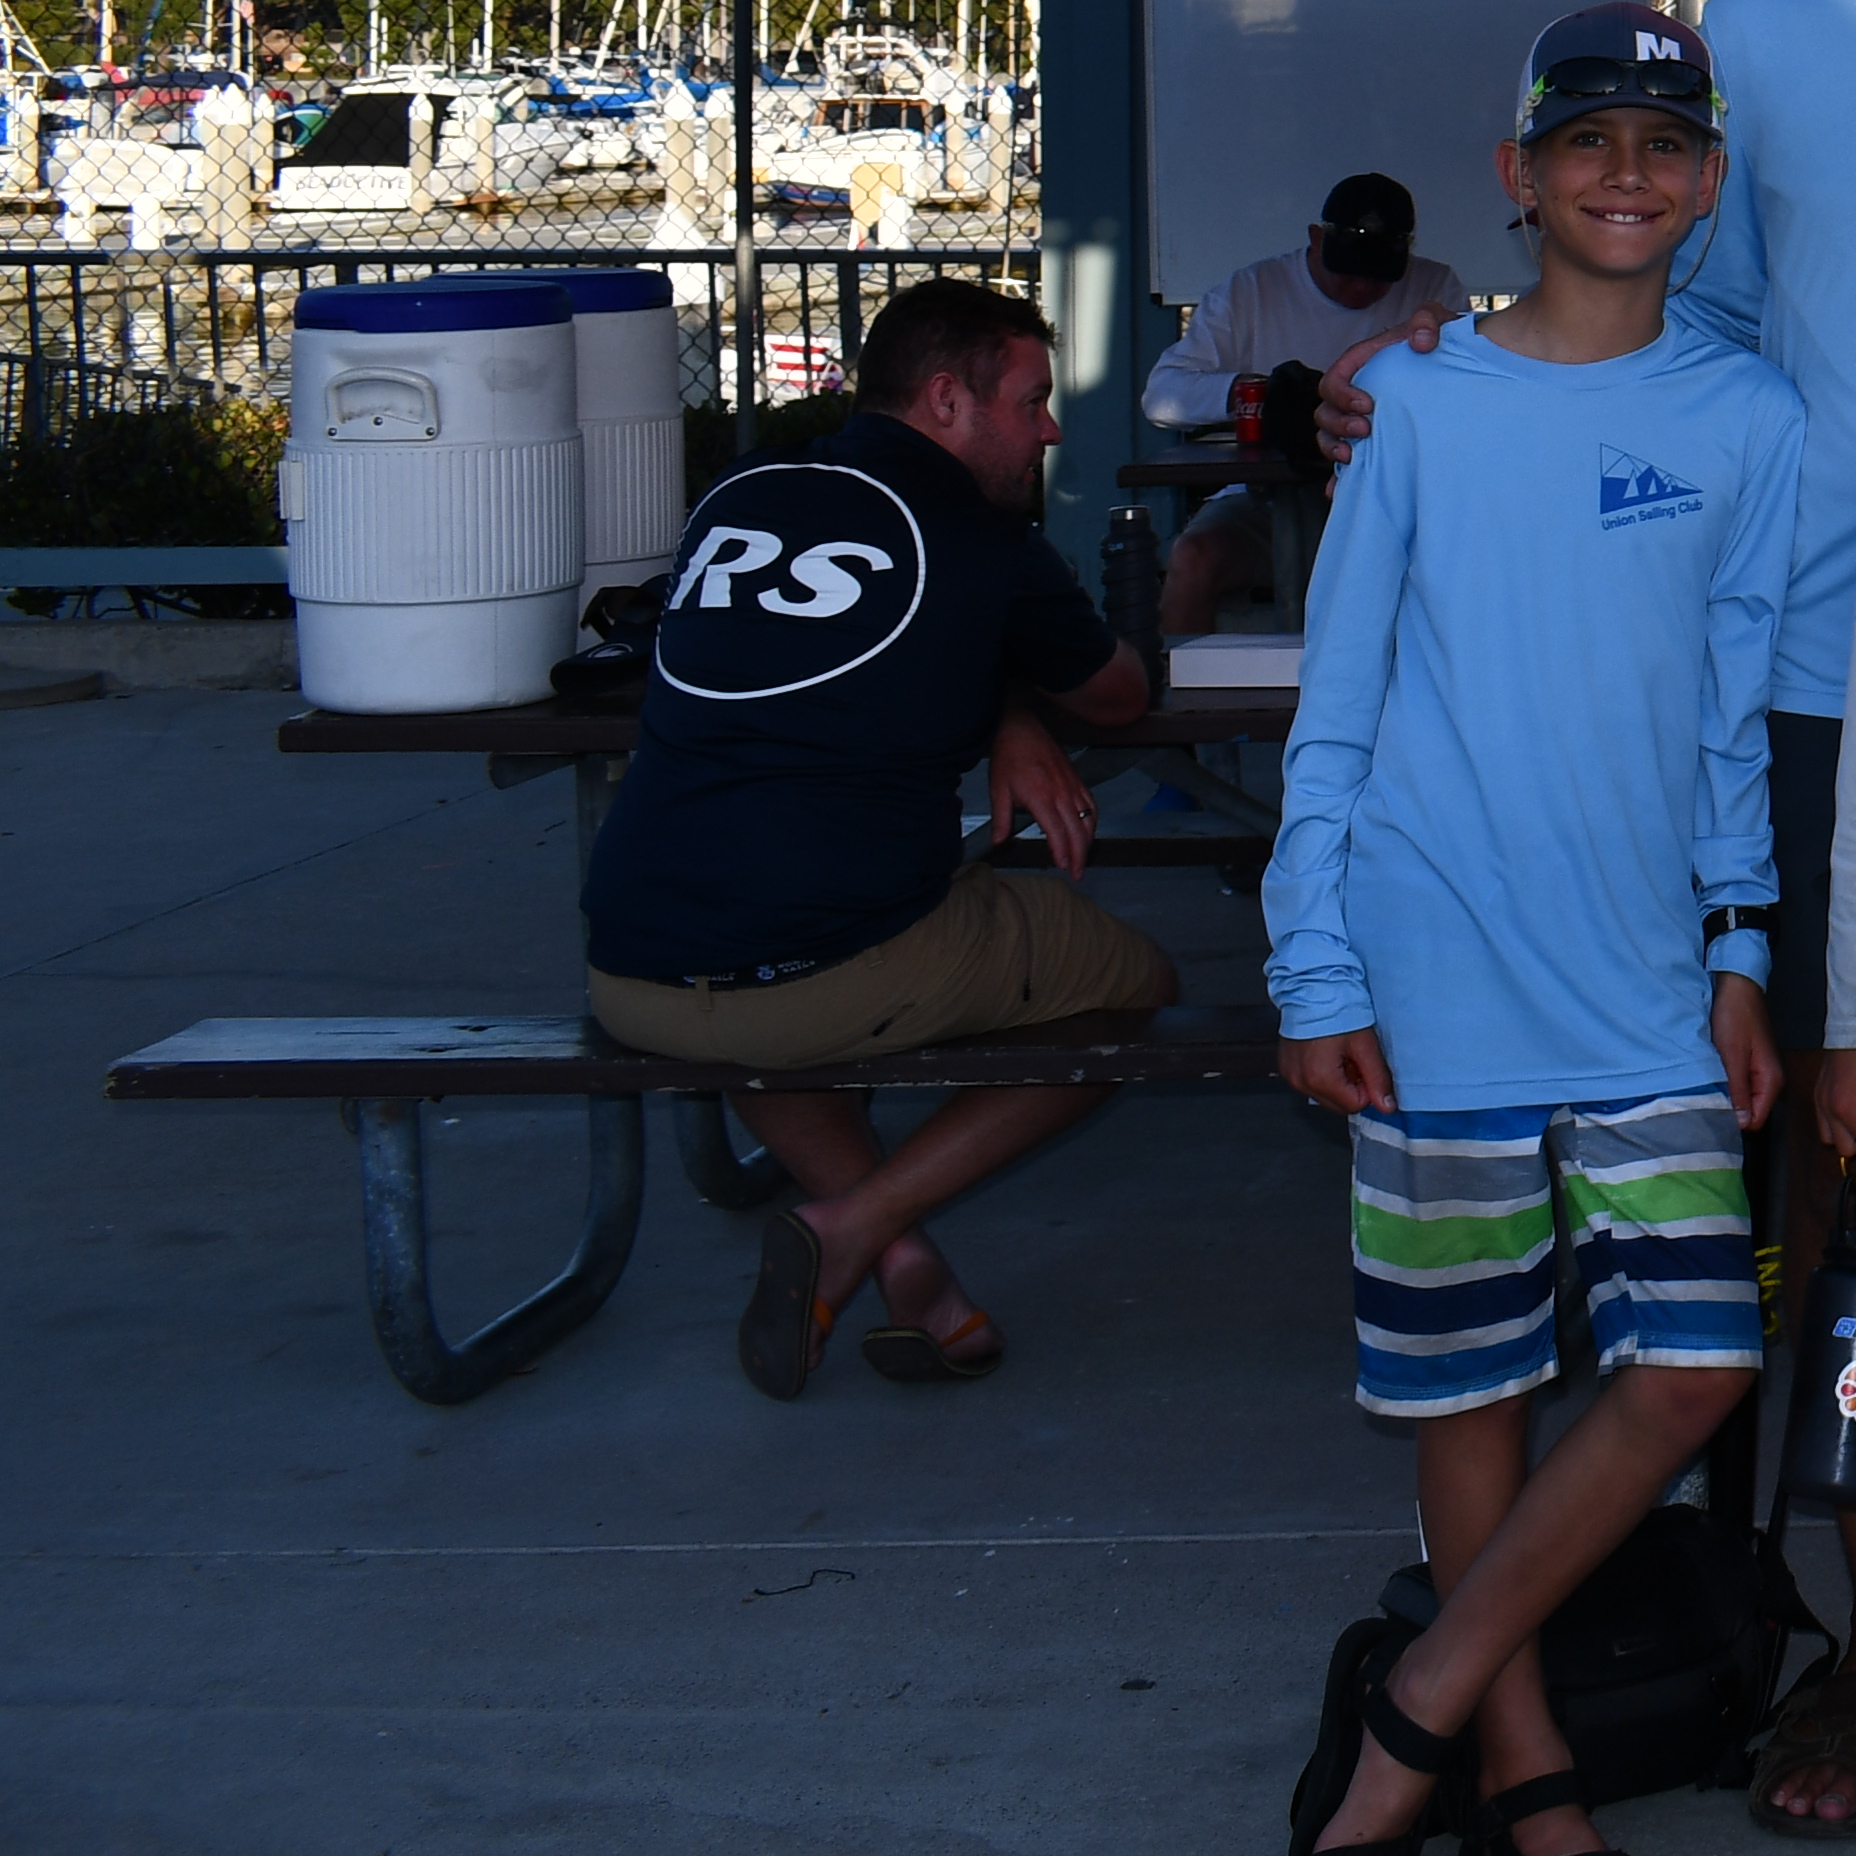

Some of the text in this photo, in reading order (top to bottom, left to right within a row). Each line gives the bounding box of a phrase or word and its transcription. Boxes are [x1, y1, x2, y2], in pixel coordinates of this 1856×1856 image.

[1602, 498, 1703, 531] Union Sailing Club
[668, 525, 895, 619] RS
